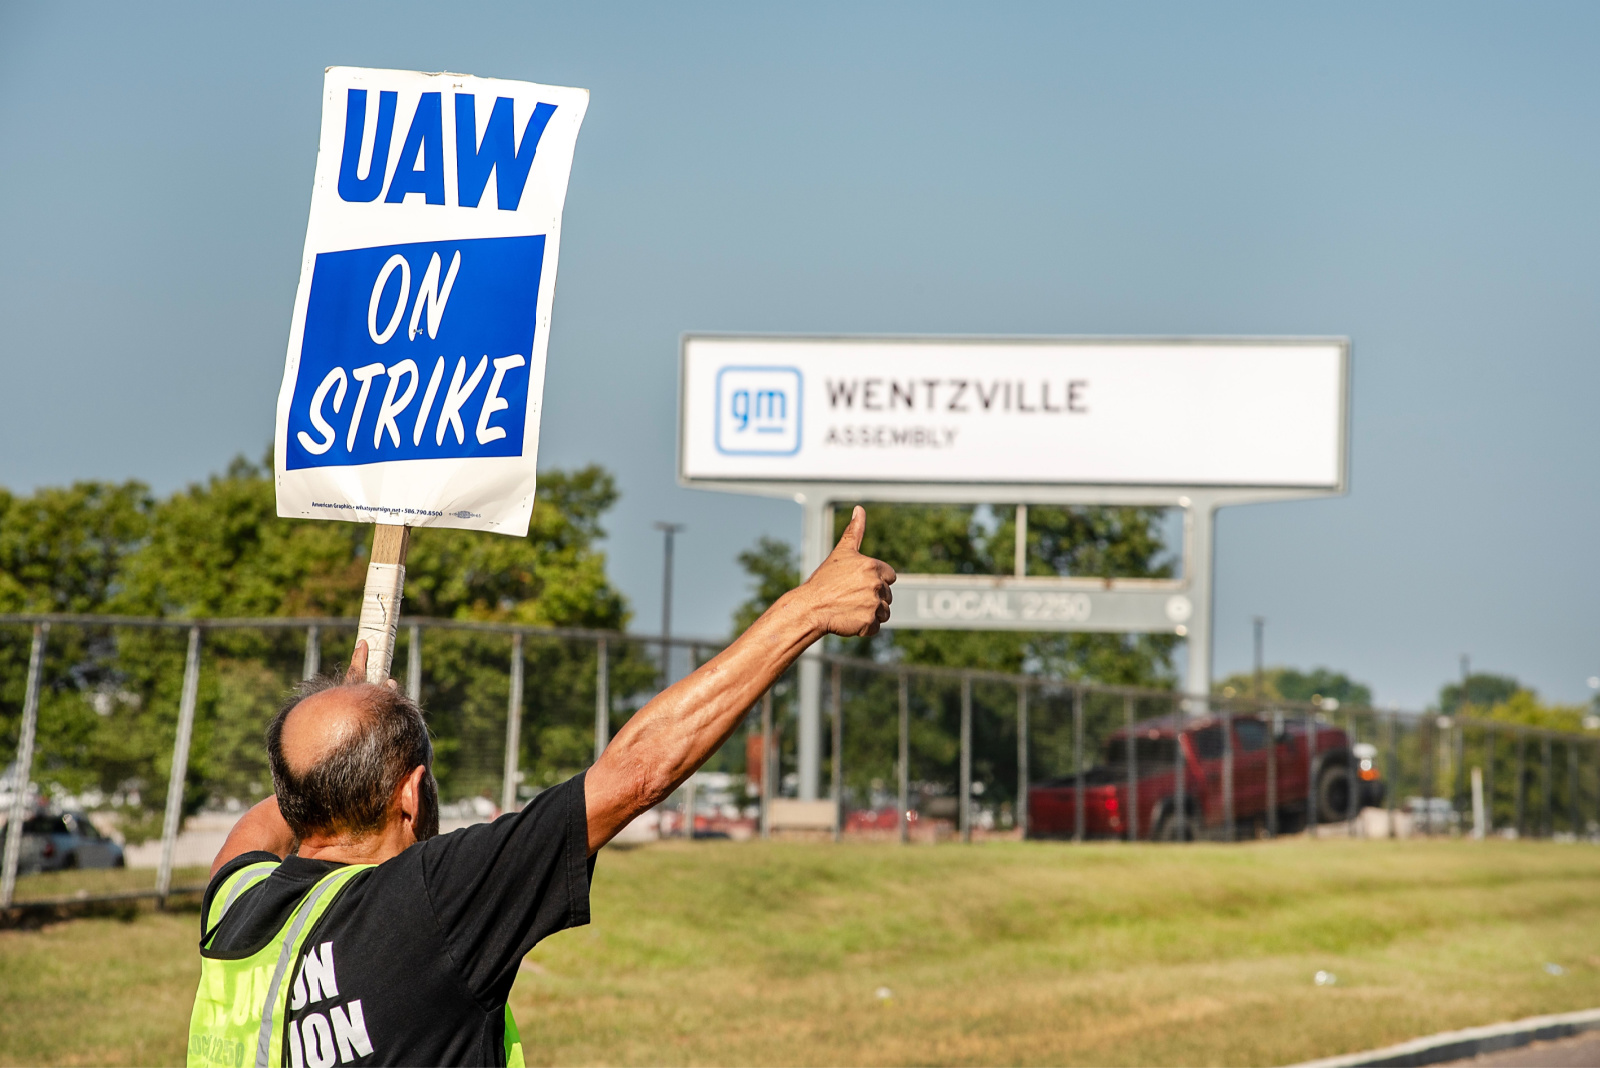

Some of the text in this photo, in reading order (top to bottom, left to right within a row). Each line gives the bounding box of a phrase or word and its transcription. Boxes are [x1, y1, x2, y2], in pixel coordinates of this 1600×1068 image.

[337, 88, 559, 212] UAW
[368, 250, 461, 345] ON
[296, 354, 526, 455] STRIKE
[731, 389, 787, 433] gm
[825, 378, 1091, 413] WENTZVILLE
[825, 426, 959, 449] ASSEMBLY
[333, 502, 352, 510] Graphics
[916, 589, 1092, 622] LOCAL 2250
